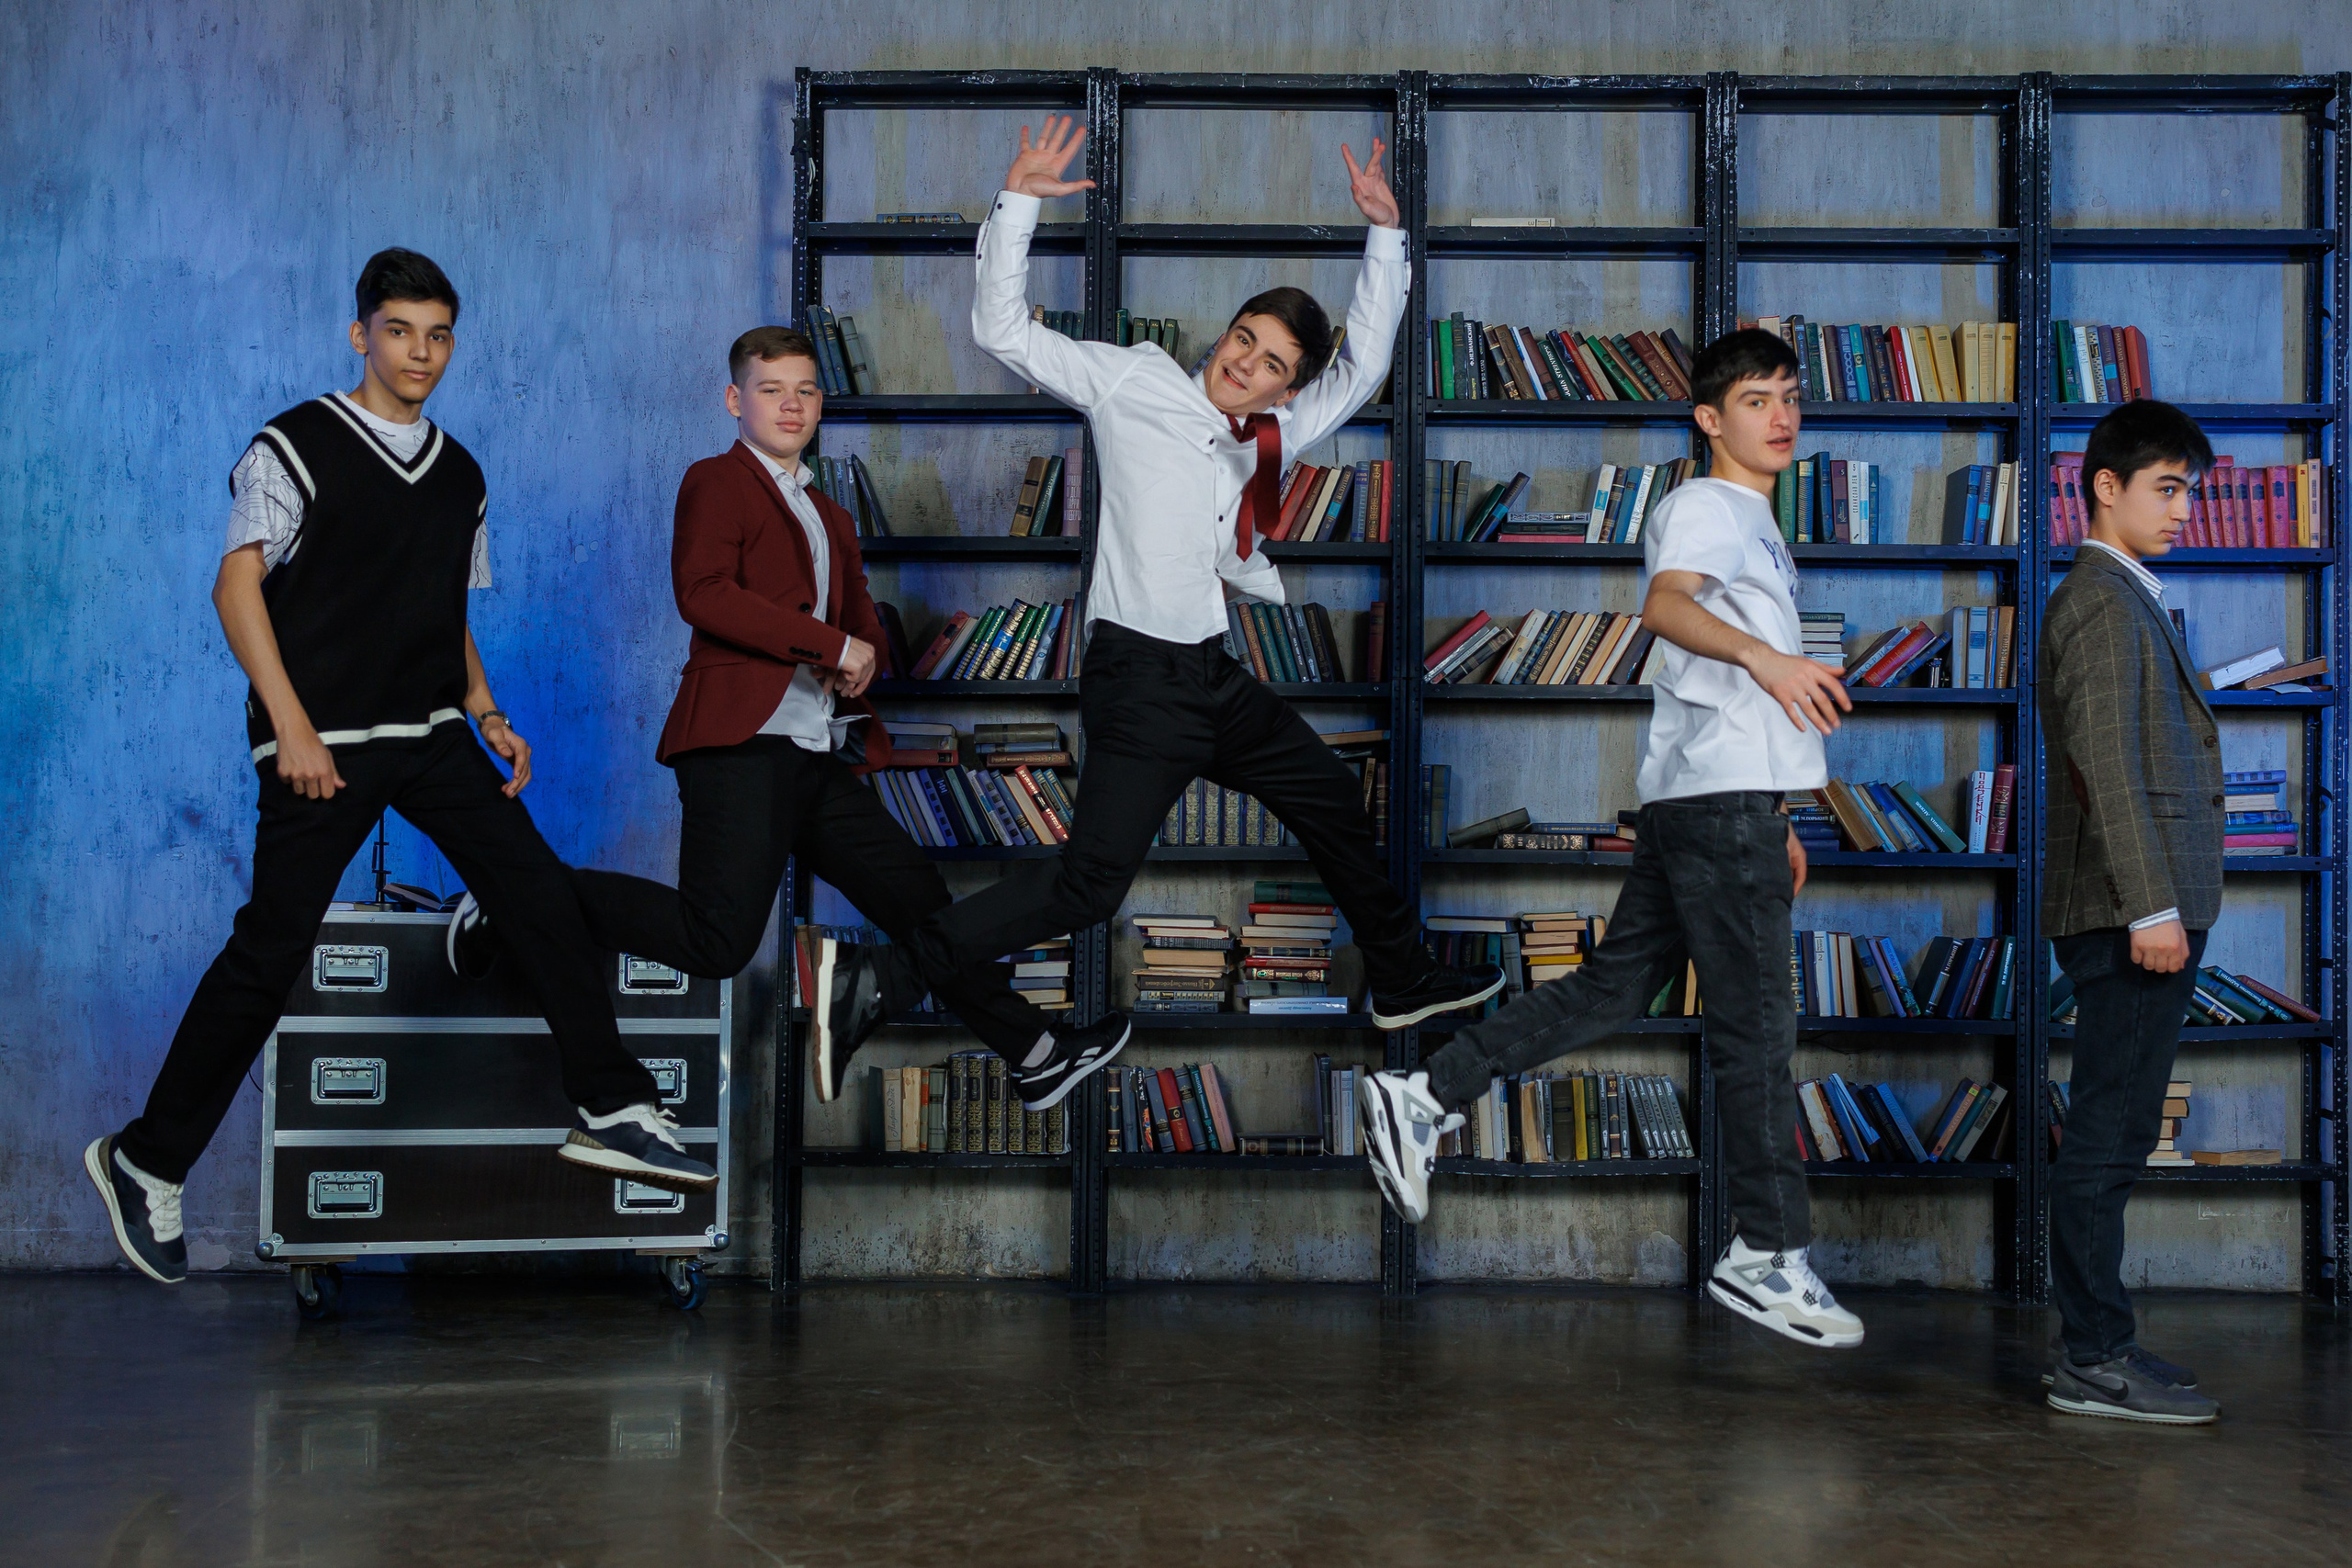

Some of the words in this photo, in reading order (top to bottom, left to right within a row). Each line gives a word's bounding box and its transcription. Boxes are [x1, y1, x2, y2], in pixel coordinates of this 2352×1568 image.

[1243, 615, 1258, 649] ШОЛОХОВ
[1252, 649, 1265, 678] МИХАИЛ
[1634, 1098, 1646, 1128] КУПРИН
